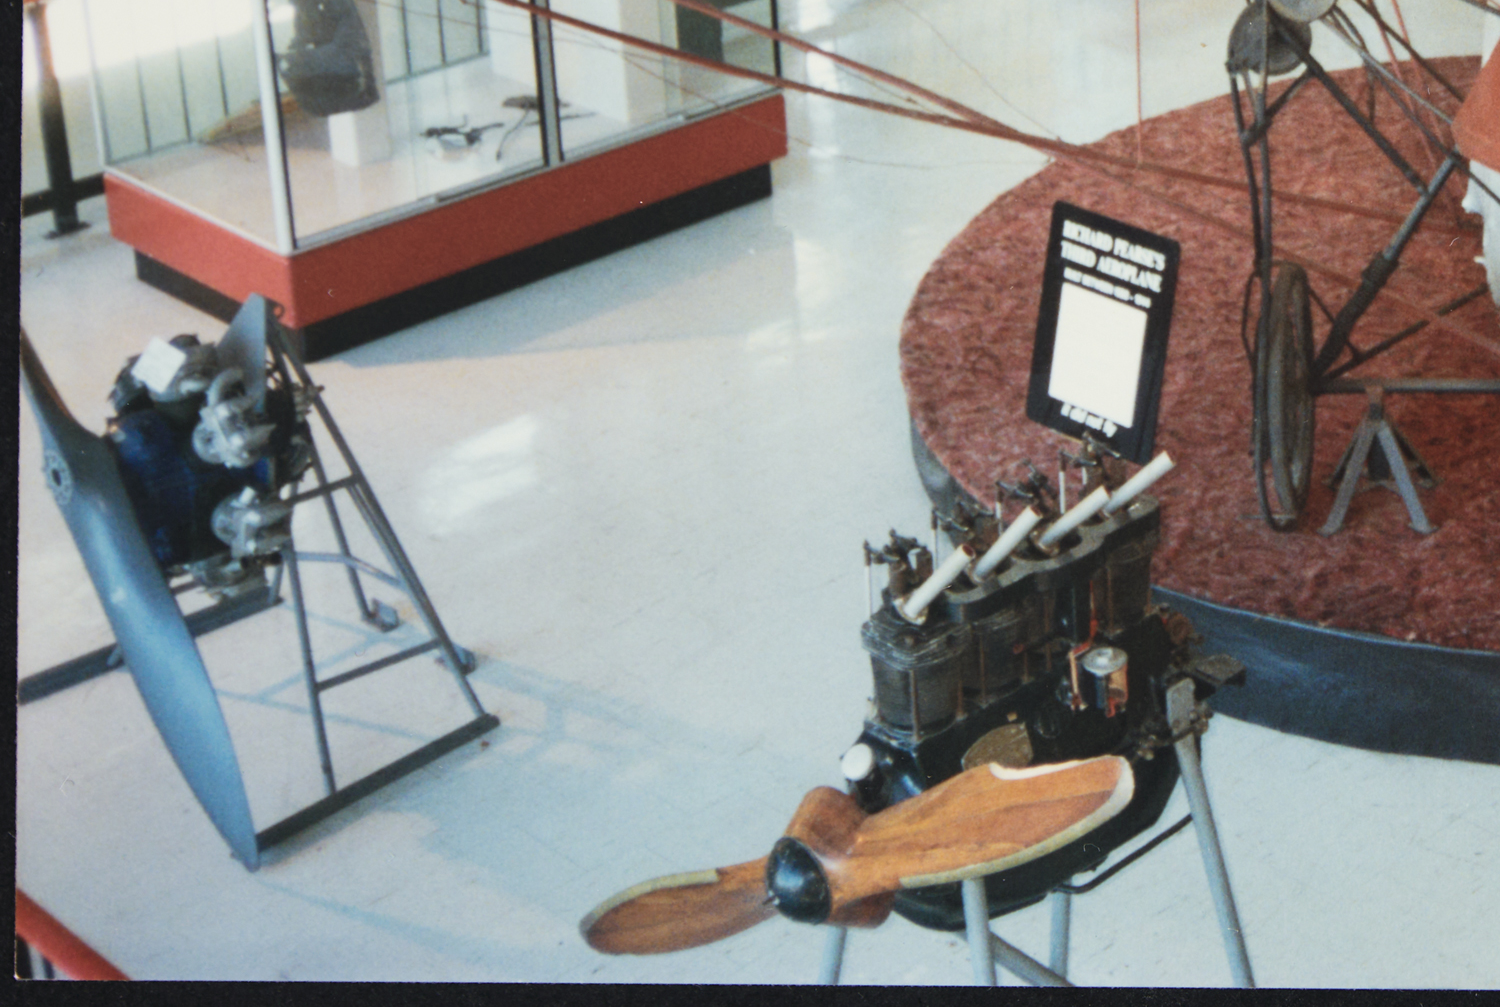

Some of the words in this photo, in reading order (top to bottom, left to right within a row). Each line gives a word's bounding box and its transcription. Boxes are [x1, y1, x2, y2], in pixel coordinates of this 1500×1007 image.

[1061, 241, 1096, 268] THIRD
[1097, 256, 1162, 293] AEROPLANE
[1063, 220, 1113, 252] RICHARD
[1113, 238, 1165, 271] PEARSE'S
